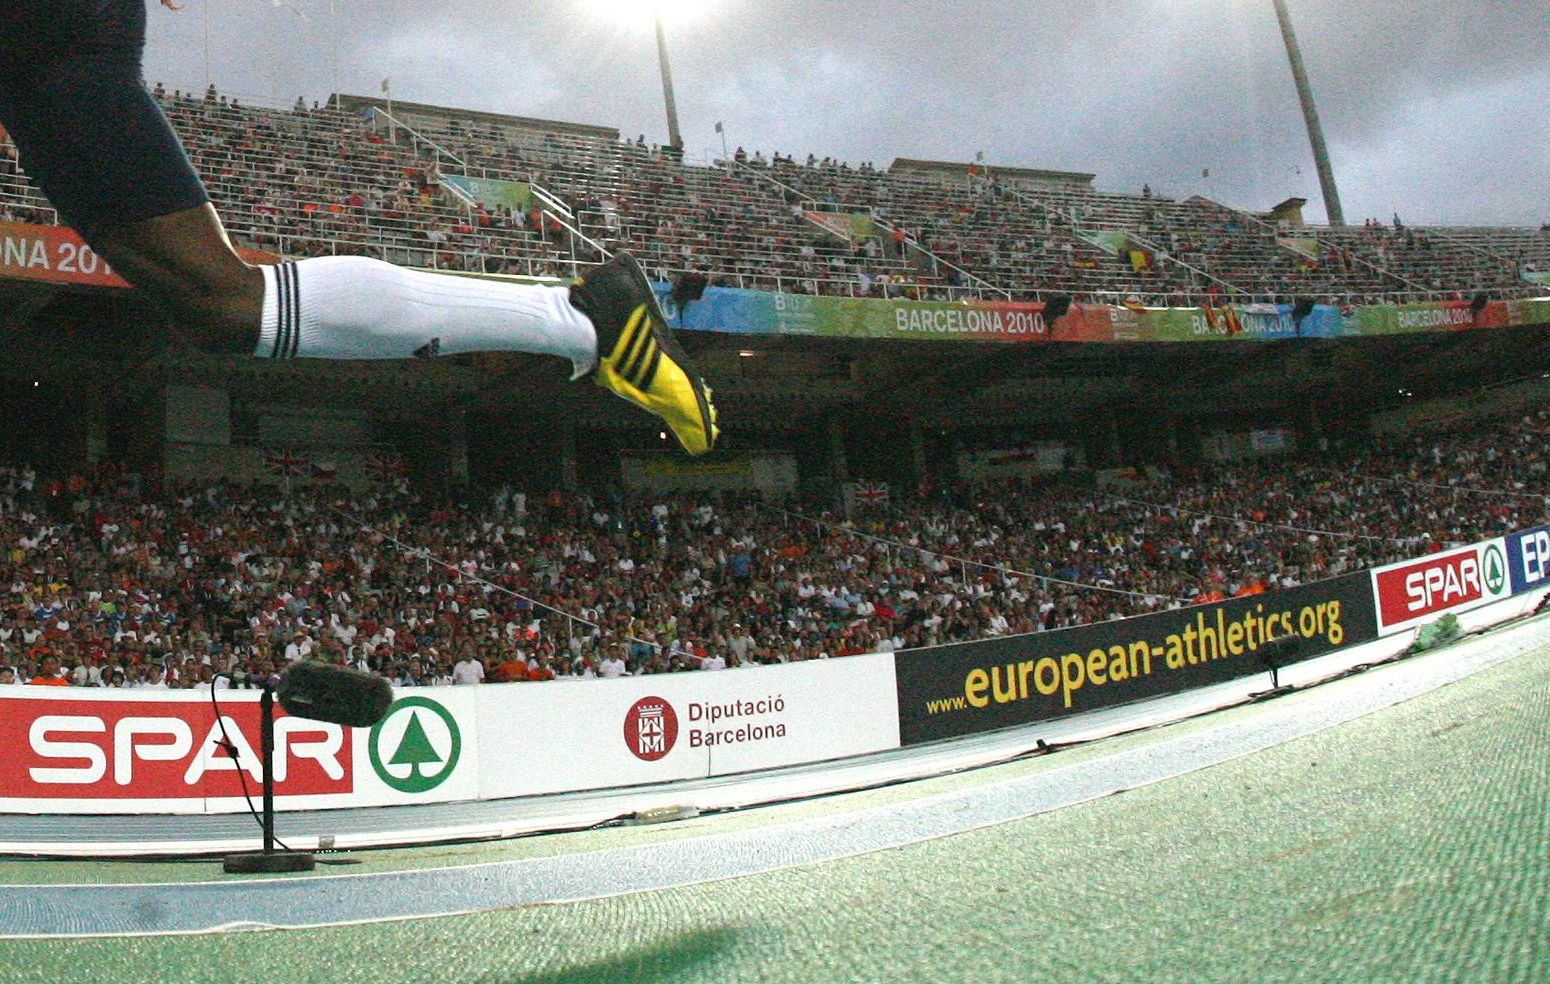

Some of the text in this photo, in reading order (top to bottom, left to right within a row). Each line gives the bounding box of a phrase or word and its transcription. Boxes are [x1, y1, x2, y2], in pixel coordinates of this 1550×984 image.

[895, 307, 1044, 334] BARCELONA 2010
[1405, 557, 1481, 612] SPAR
[688, 694, 785, 724] Diputació
[28, 715, 345, 786] SPAR
[689, 723, 786, 748] Barcelona
